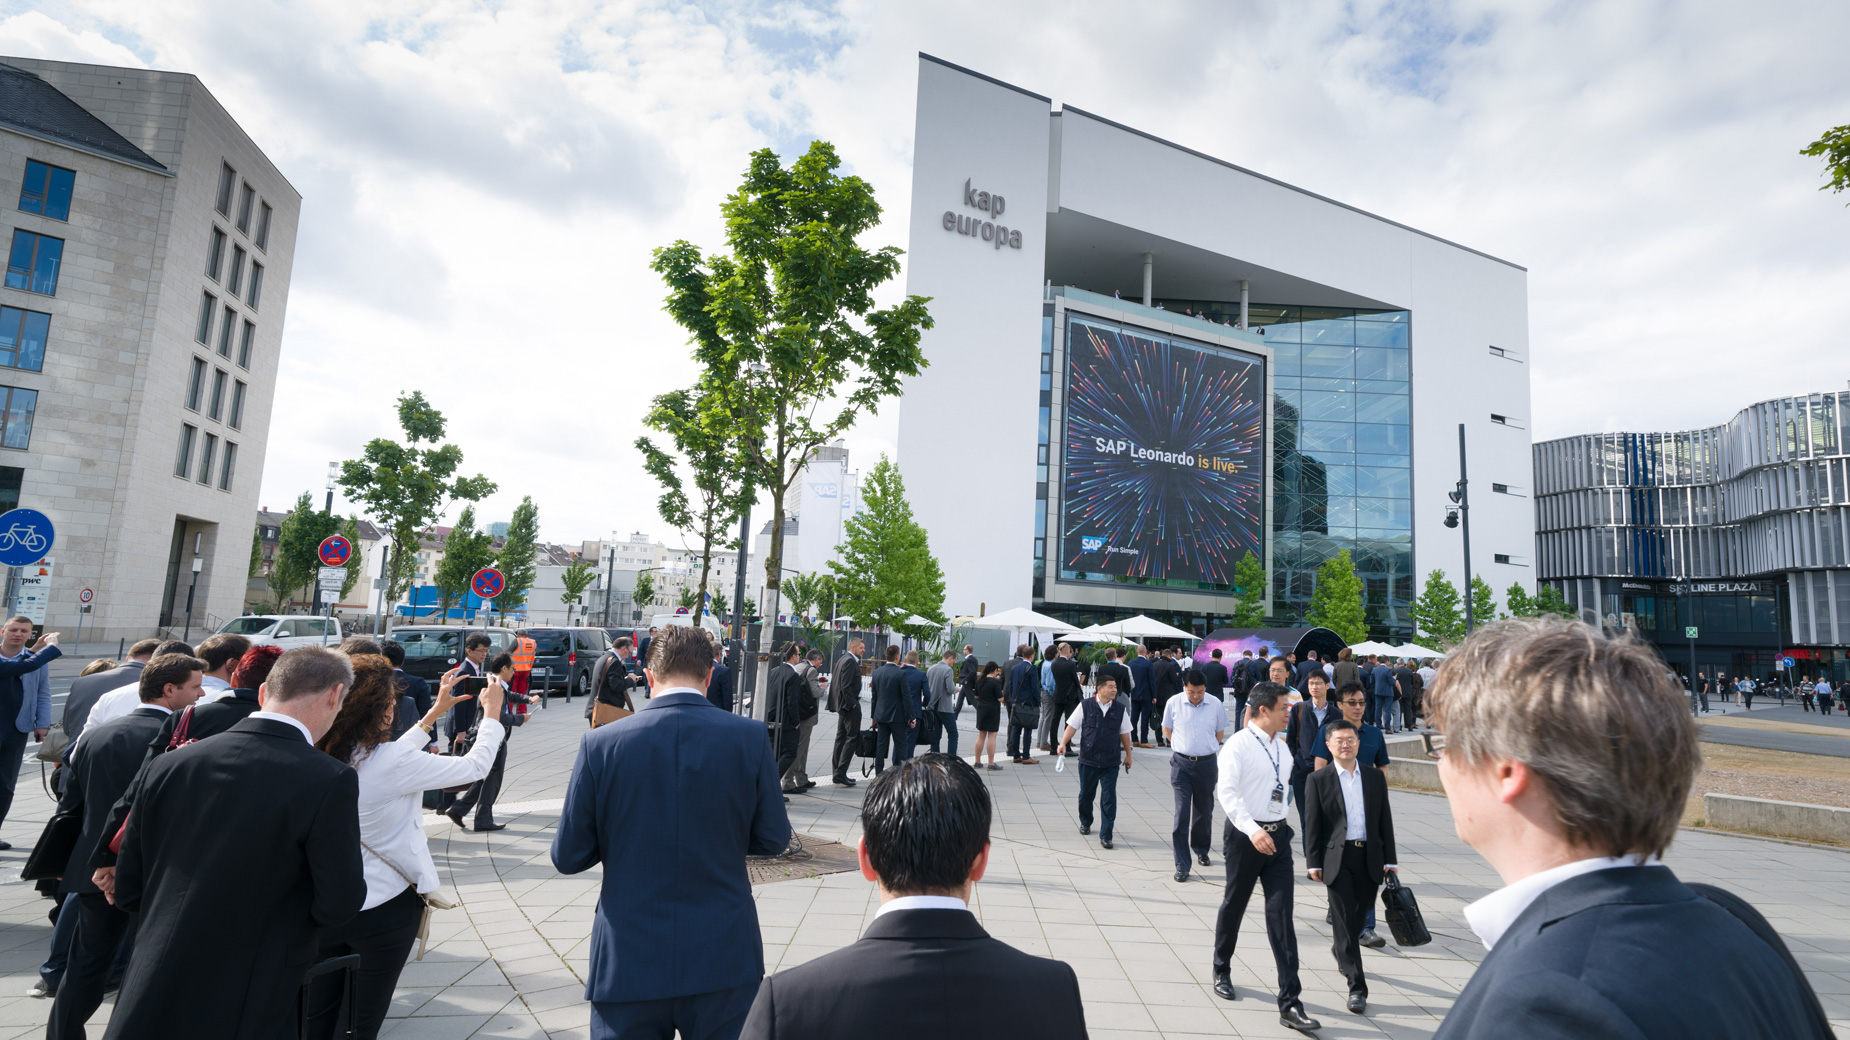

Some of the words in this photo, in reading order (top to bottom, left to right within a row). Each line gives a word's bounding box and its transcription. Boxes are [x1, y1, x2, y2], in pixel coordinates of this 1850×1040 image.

[964, 177, 1006, 219] kap
[942, 211, 1023, 250] europa
[1095, 437, 1127, 455] SAP
[1130, 443, 1195, 467] Leonardo
[1198, 454, 1210, 469] is
[1212, 456, 1239, 474] live.
[1082, 538, 1102, 551] SAP
[1107, 545, 1119, 553] Run
[1120, 546, 1139, 556] Simple
[21, 577, 42, 586] pwc
[1669, 583, 1716, 592] SKLINE
[1718, 583, 1758, 592] PLAZA
[82, 592, 91, 600] 10
